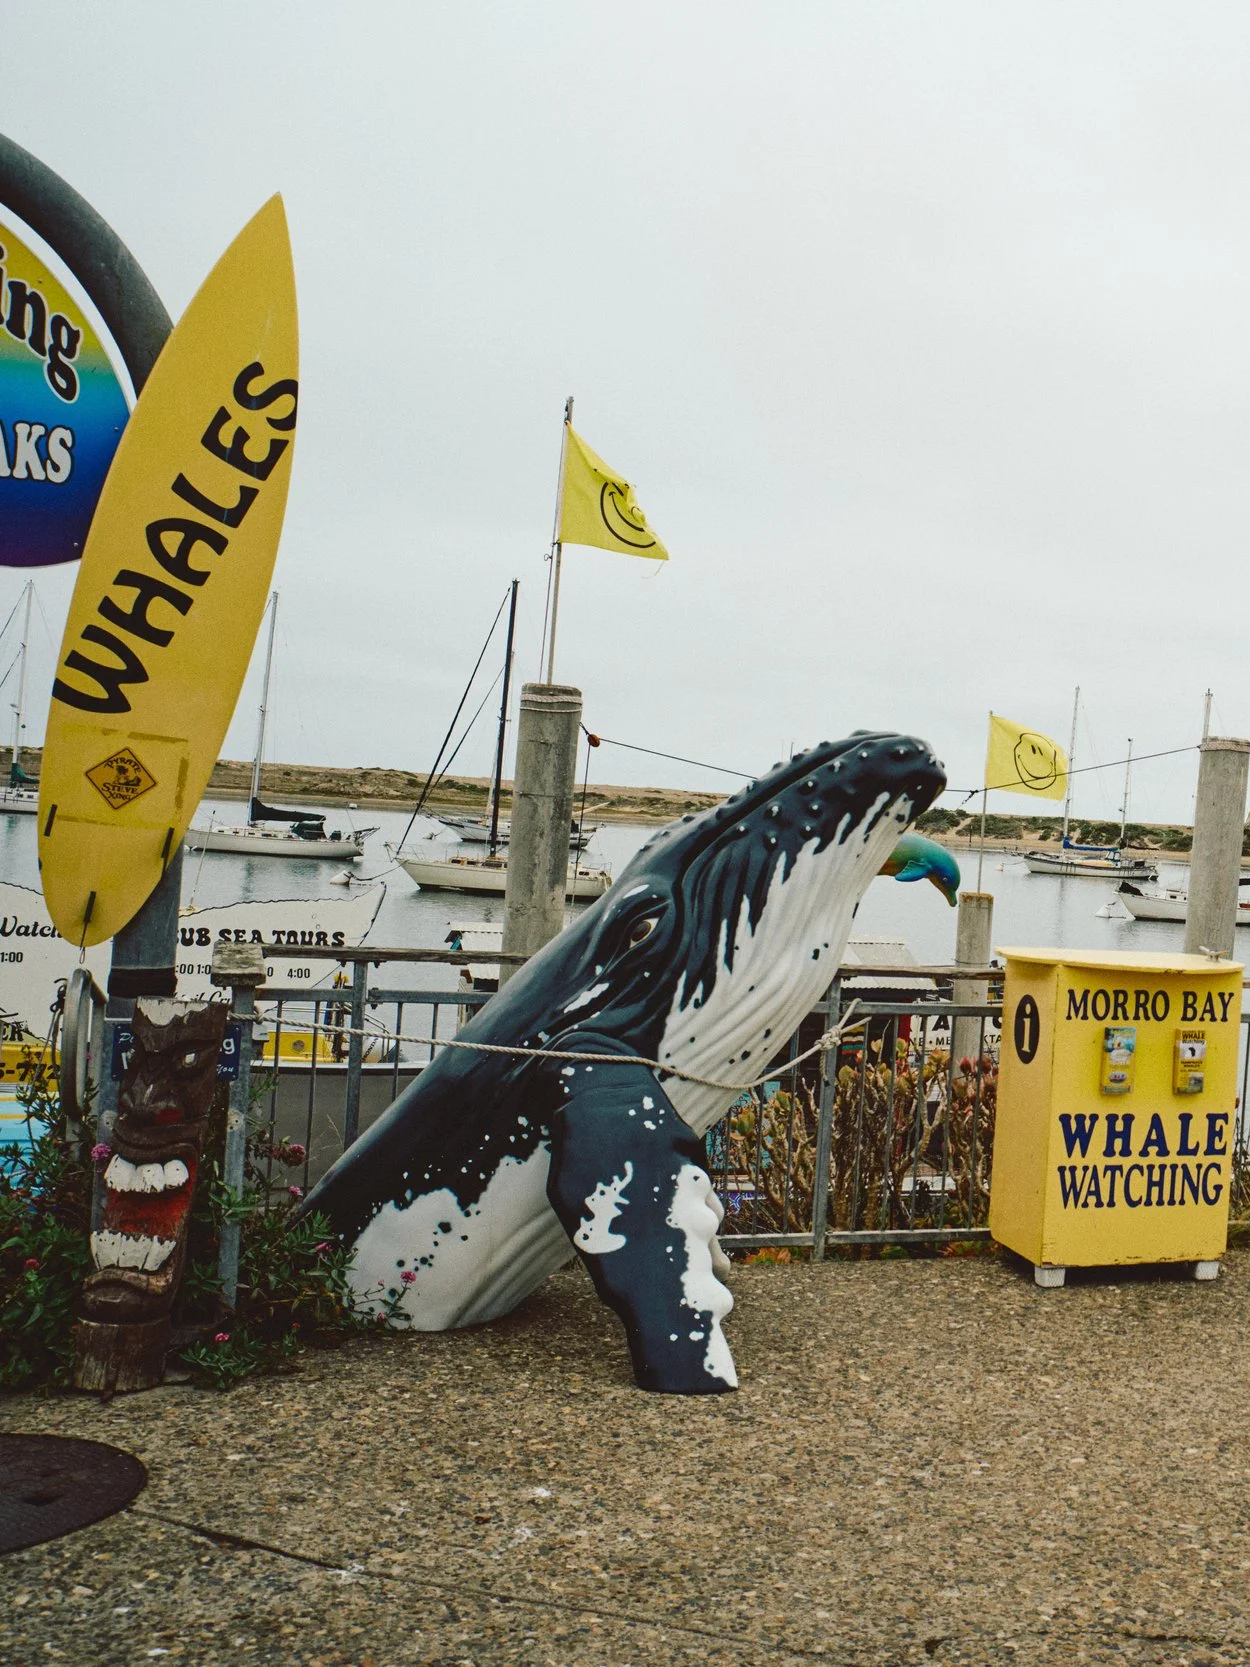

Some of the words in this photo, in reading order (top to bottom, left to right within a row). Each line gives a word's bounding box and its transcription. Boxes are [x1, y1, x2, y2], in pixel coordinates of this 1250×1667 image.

[52, 361, 299, 713] WHALES
[101, 782, 138, 795] STEVE
[218, 928, 265, 944] SEA
[272, 929, 346, 947] TOURS
[287, 967, 311, 979] 4:00
[1066, 989, 1171, 1022] MORRO
[1180, 991, 1235, 1022] BAY
[1058, 1112, 1229, 1159] WHALE
[1057, 1162, 1224, 1210] WATCHING
